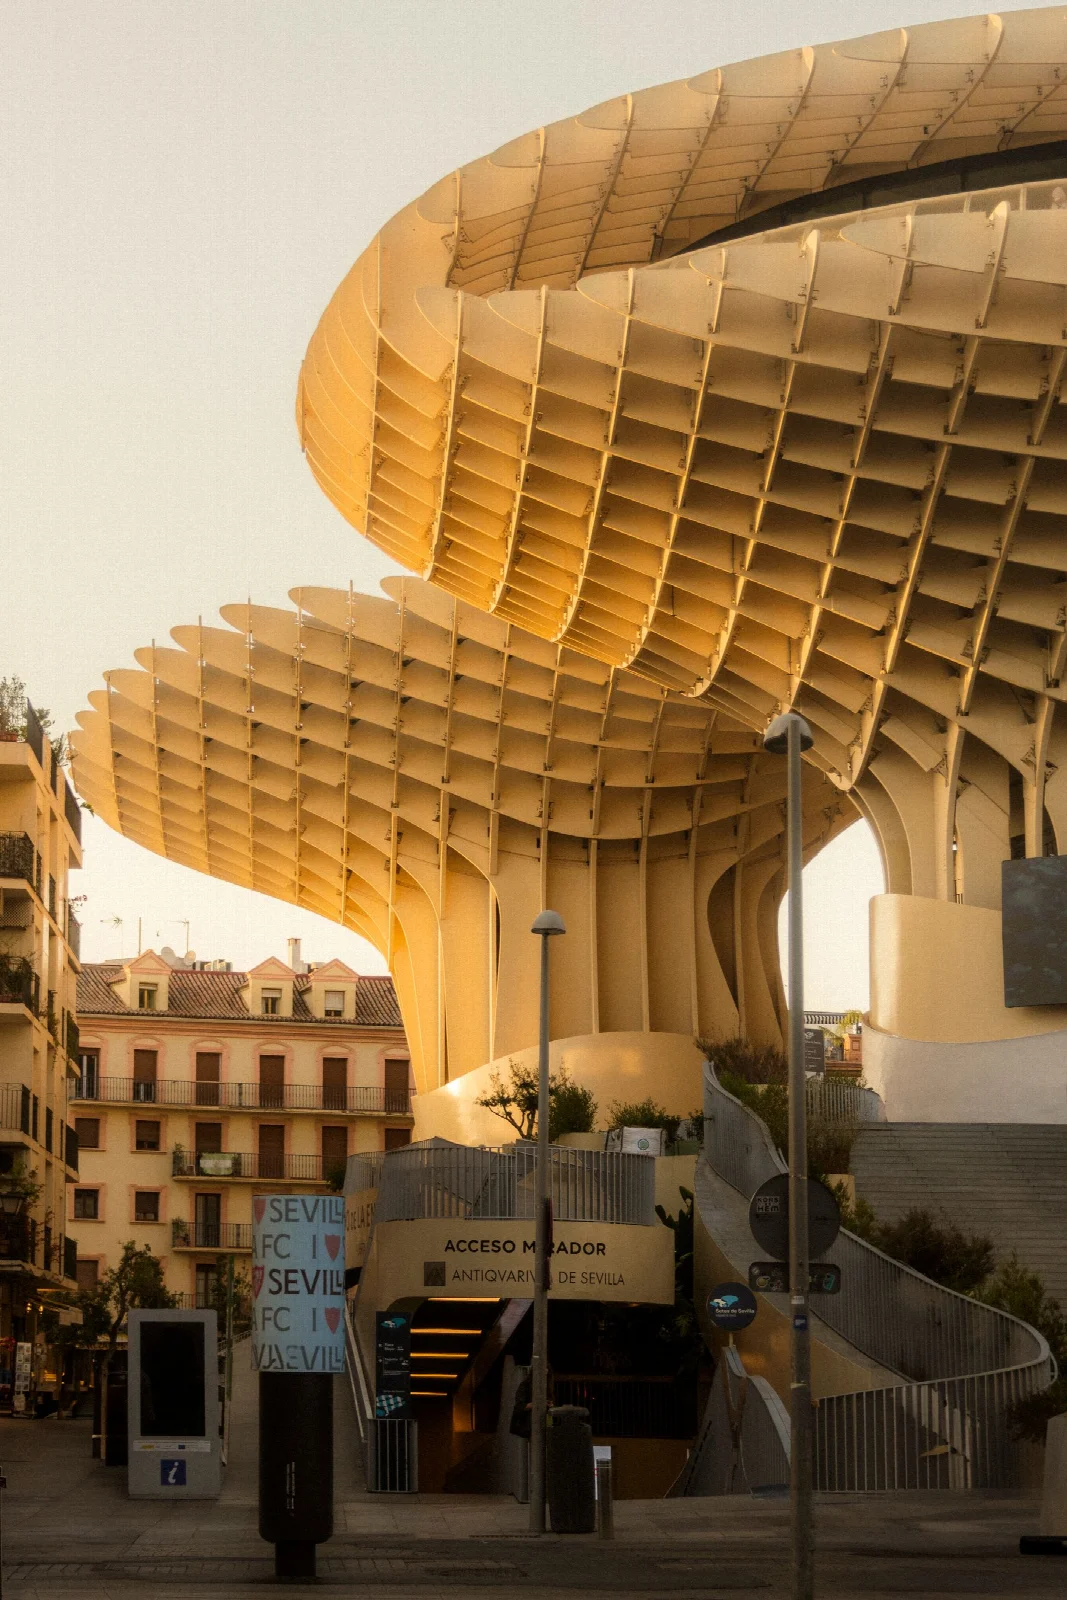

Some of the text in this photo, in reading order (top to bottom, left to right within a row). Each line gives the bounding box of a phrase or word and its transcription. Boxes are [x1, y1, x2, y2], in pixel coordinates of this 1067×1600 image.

[312, 1234, 317, 1260] I
[444, 1240, 516, 1254] ACCESO
[559, 1271, 576, 1284] DE
[581, 1272, 625, 1286] SEVILLA
[312, 1307, 317, 1333] I
